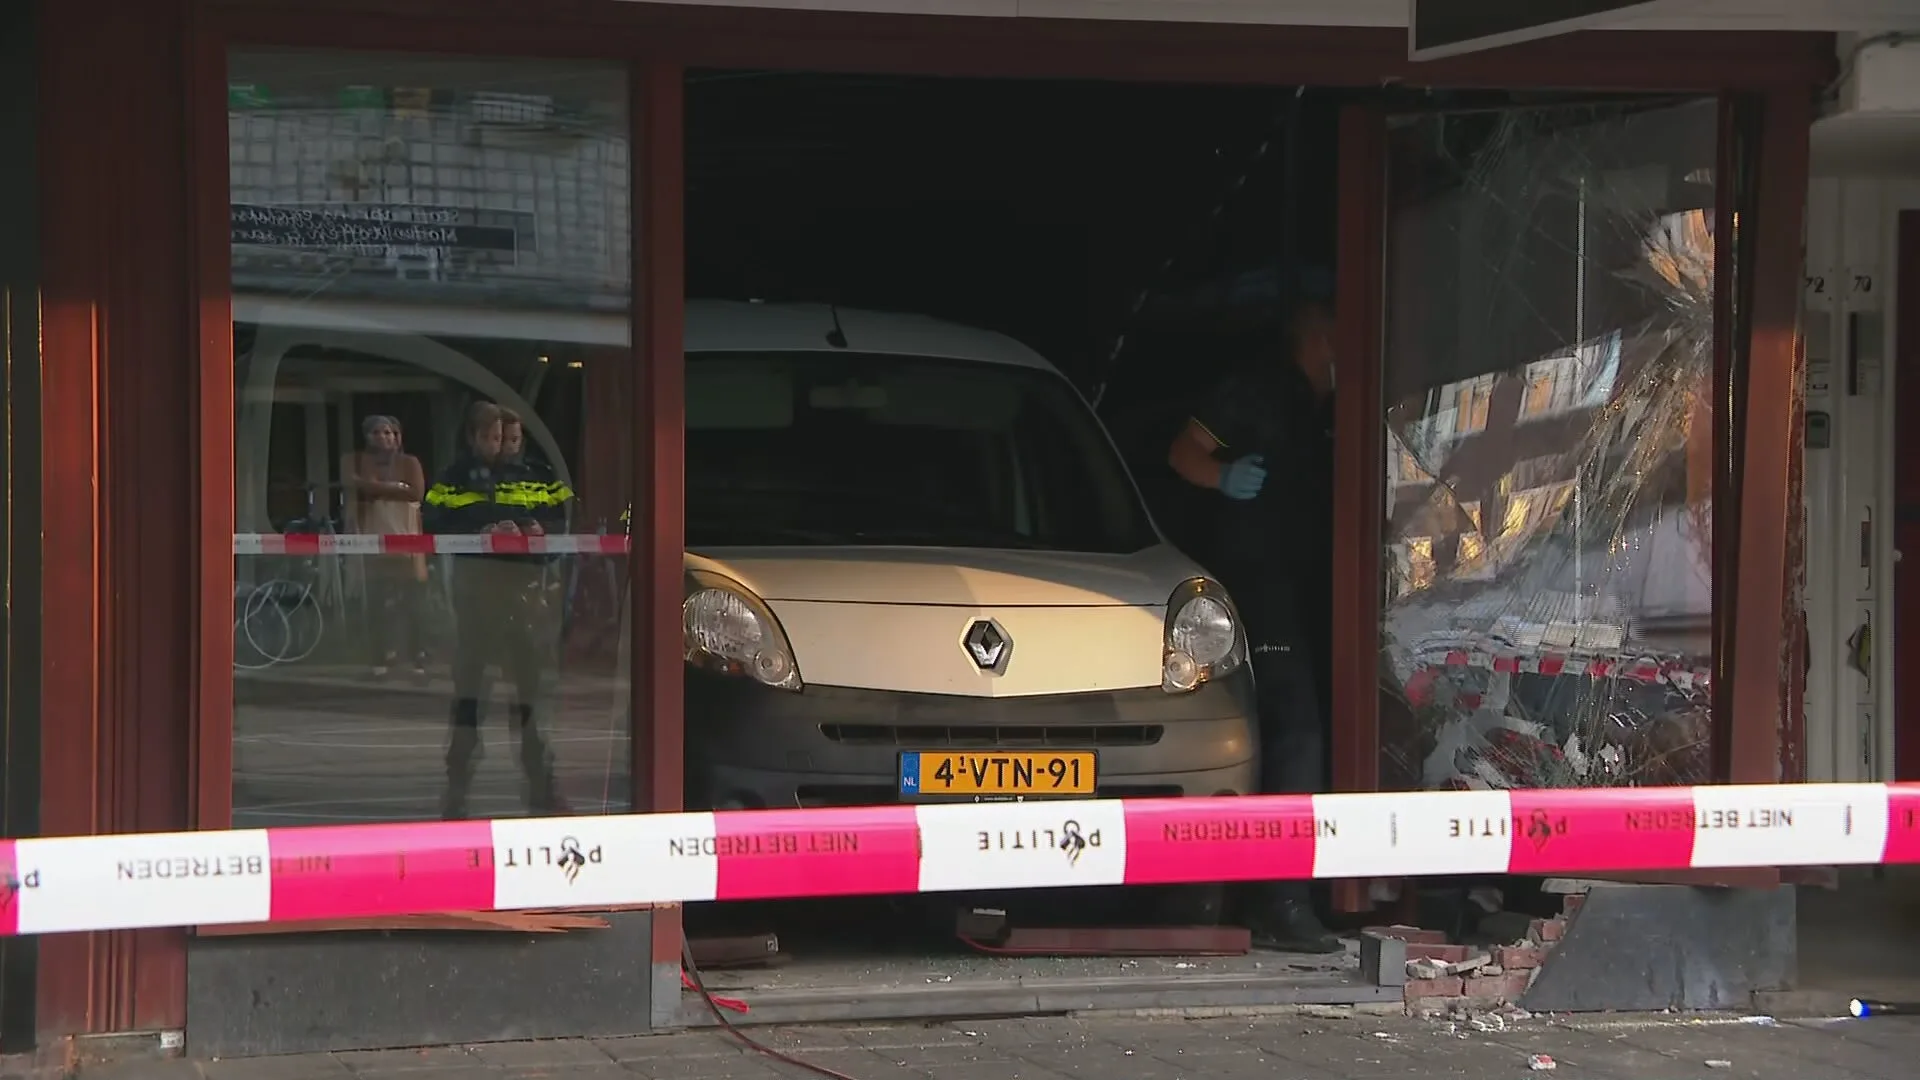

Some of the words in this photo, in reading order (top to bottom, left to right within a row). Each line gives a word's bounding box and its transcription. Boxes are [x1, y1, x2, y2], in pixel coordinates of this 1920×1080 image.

[1852, 275, 1873, 292] 70
[903, 777, 917, 787] NL
[1290, 819, 1337, 838] NIET
[1624, 809, 1739, 830] BETREDEN
[1749, 809, 1793, 828] NIET
[1164, 819, 1282, 841] BETREDEN
[669, 833, 798, 857] BETREDEN
[807, 831, 859, 854] NIET
[117, 855, 262, 880] BETREDEN
